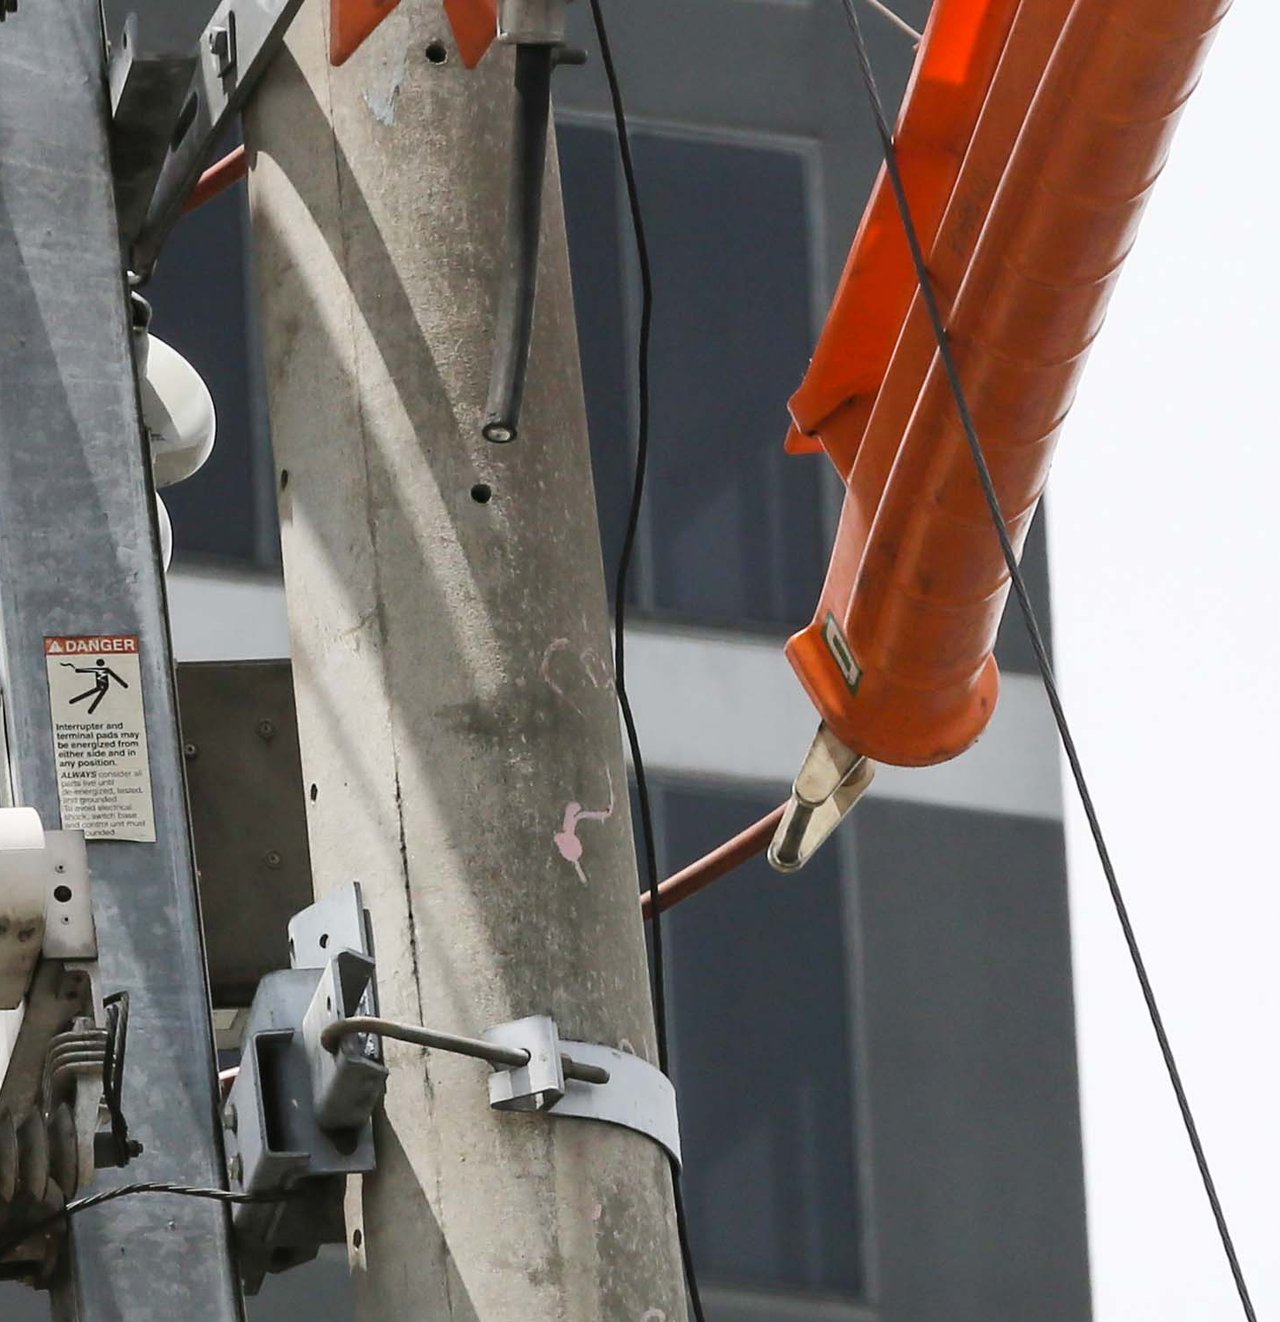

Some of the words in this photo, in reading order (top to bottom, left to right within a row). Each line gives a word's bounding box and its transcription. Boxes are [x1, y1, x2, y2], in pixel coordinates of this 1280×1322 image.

[65, 638, 136, 652] DANGER
[55, 723, 103, 731] Interrupter
[106, 722, 123, 730] and
[56, 732, 93, 740] terminal
[96, 732, 118, 741] pads
[120, 732, 139, 740] may
[71, 741, 115, 749] energized
[87, 749, 106, 757] side
[108, 749, 125, 757] and
[59, 760, 75, 768] any
[78, 759, 117, 768] position.
